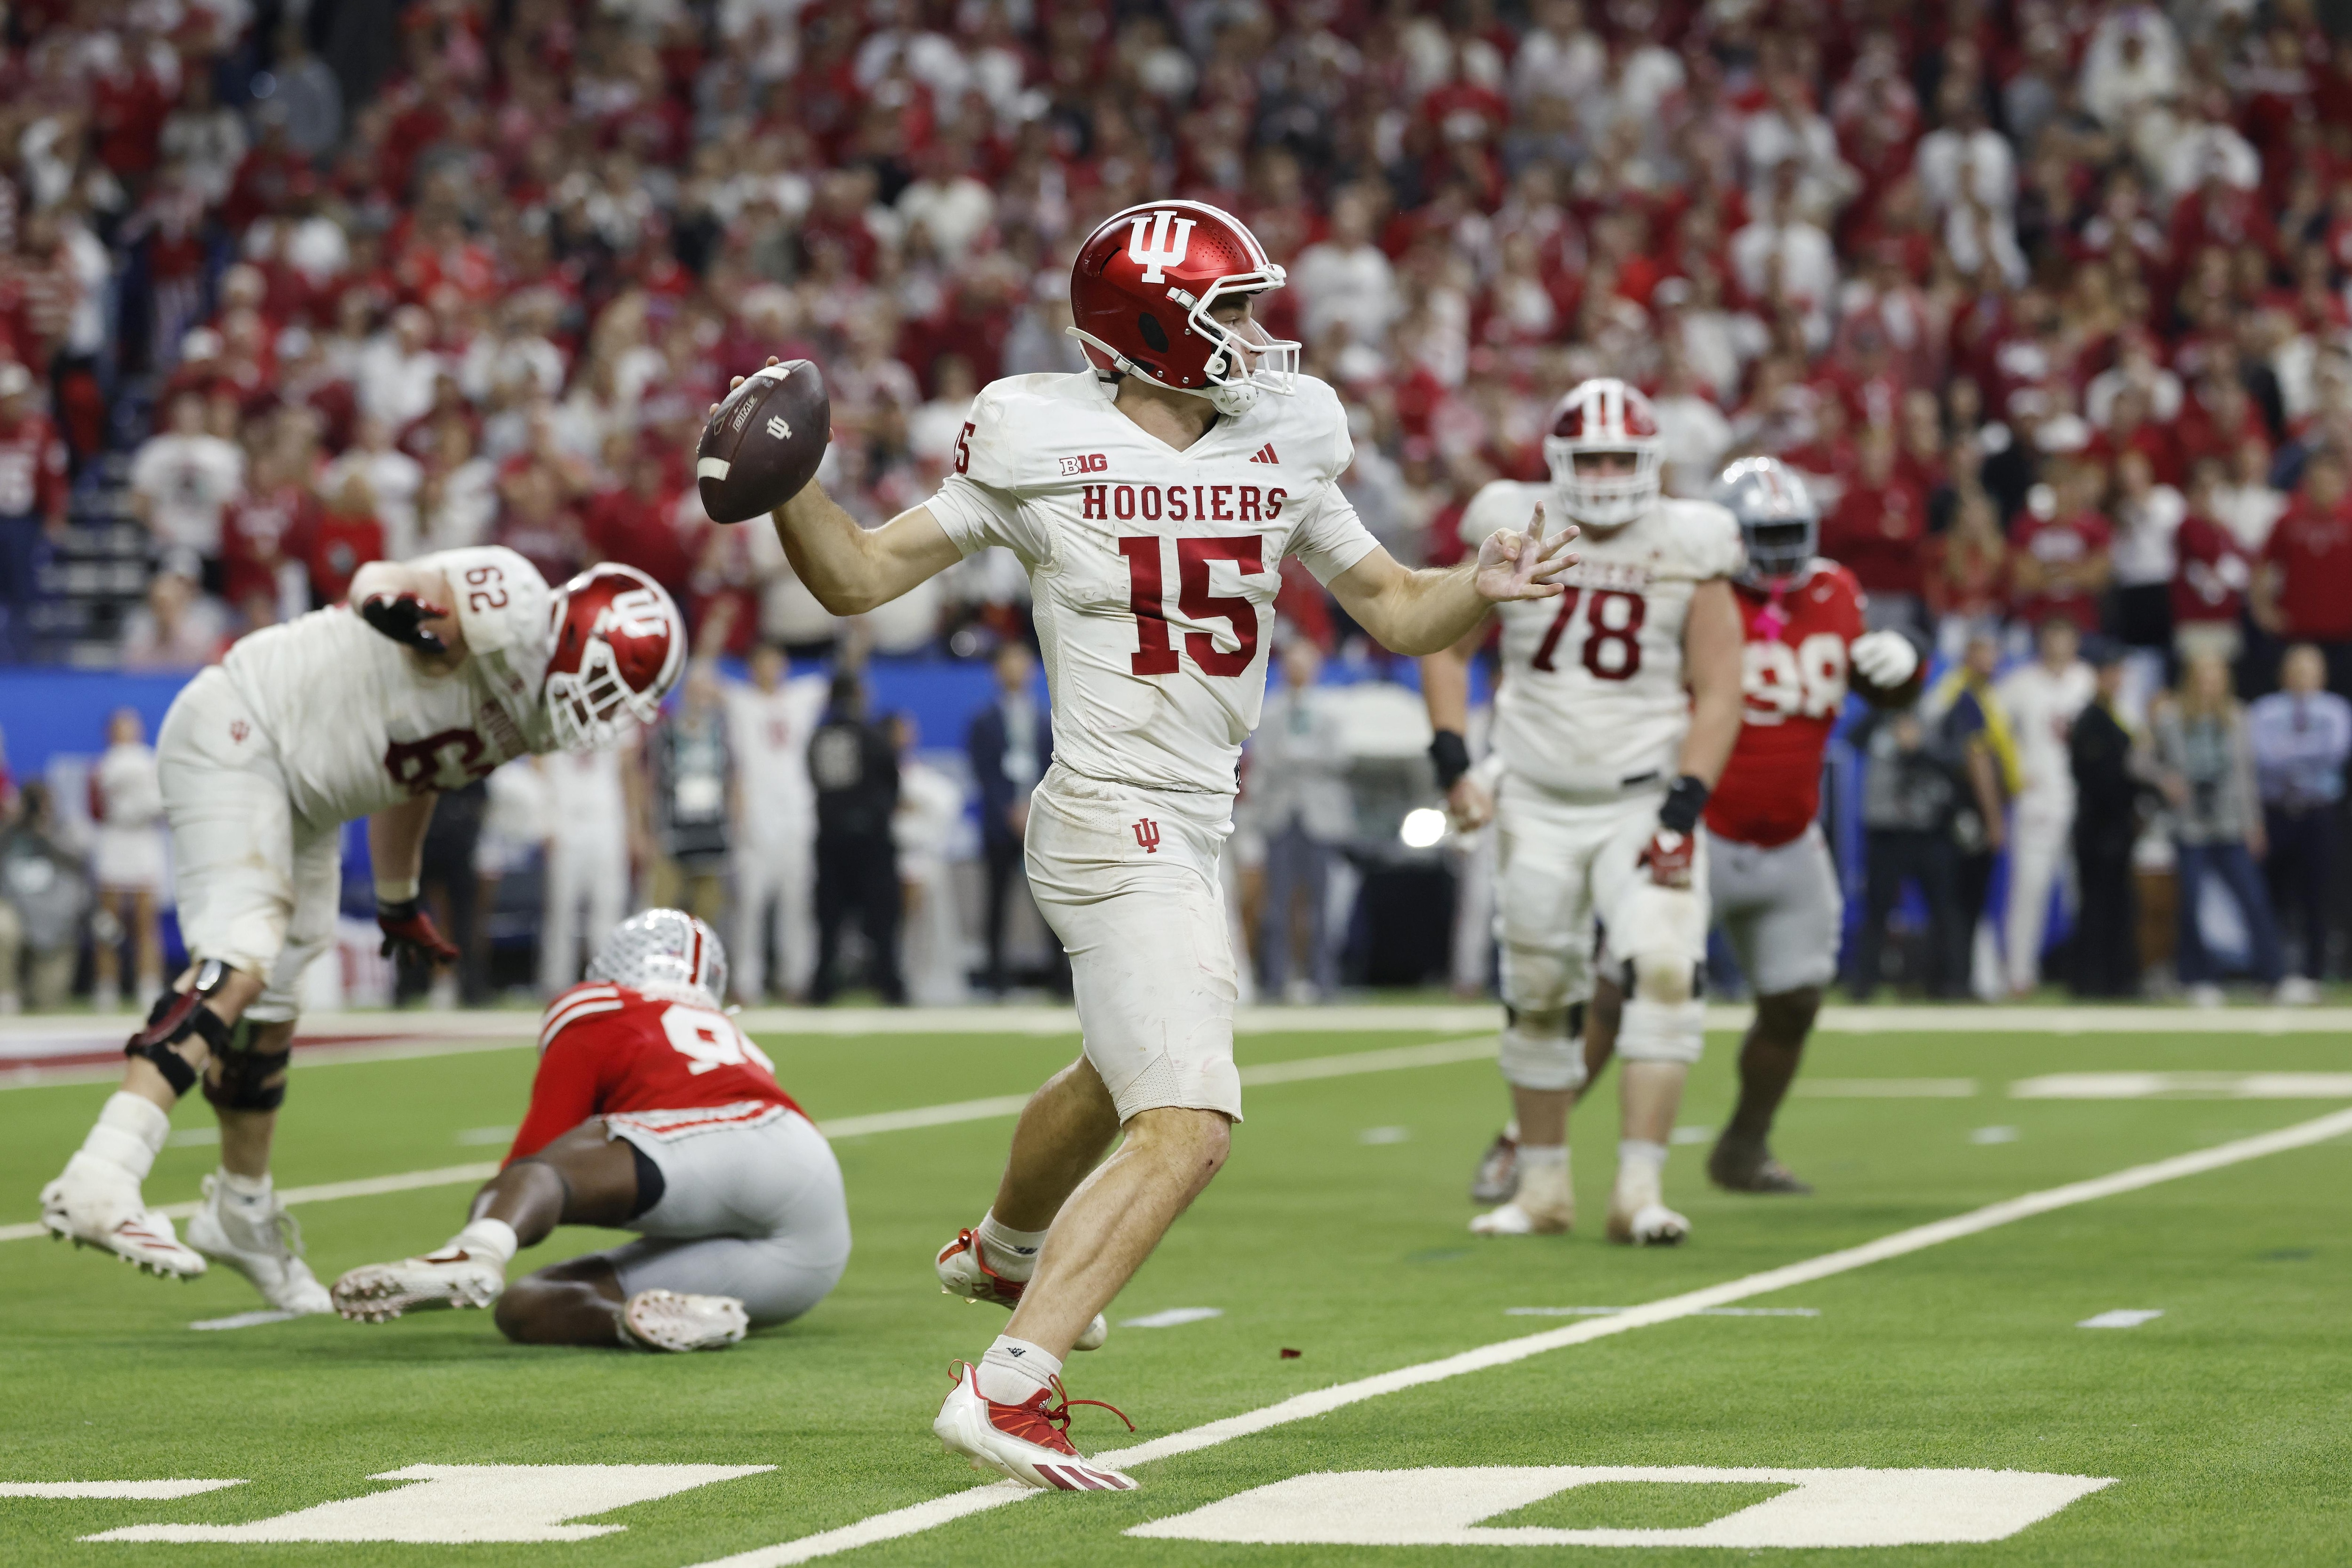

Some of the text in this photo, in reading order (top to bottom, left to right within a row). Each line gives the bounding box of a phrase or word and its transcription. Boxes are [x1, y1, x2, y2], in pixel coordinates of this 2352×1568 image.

[954, 419, 976, 475] 5
[1082, 485, 1288, 521] HOOSIERS
[466, 566, 509, 614] 62
[1119, 535, 1263, 677] 15
[1529, 583, 1645, 680] 78
[660, 1003, 775, 1076] 9
